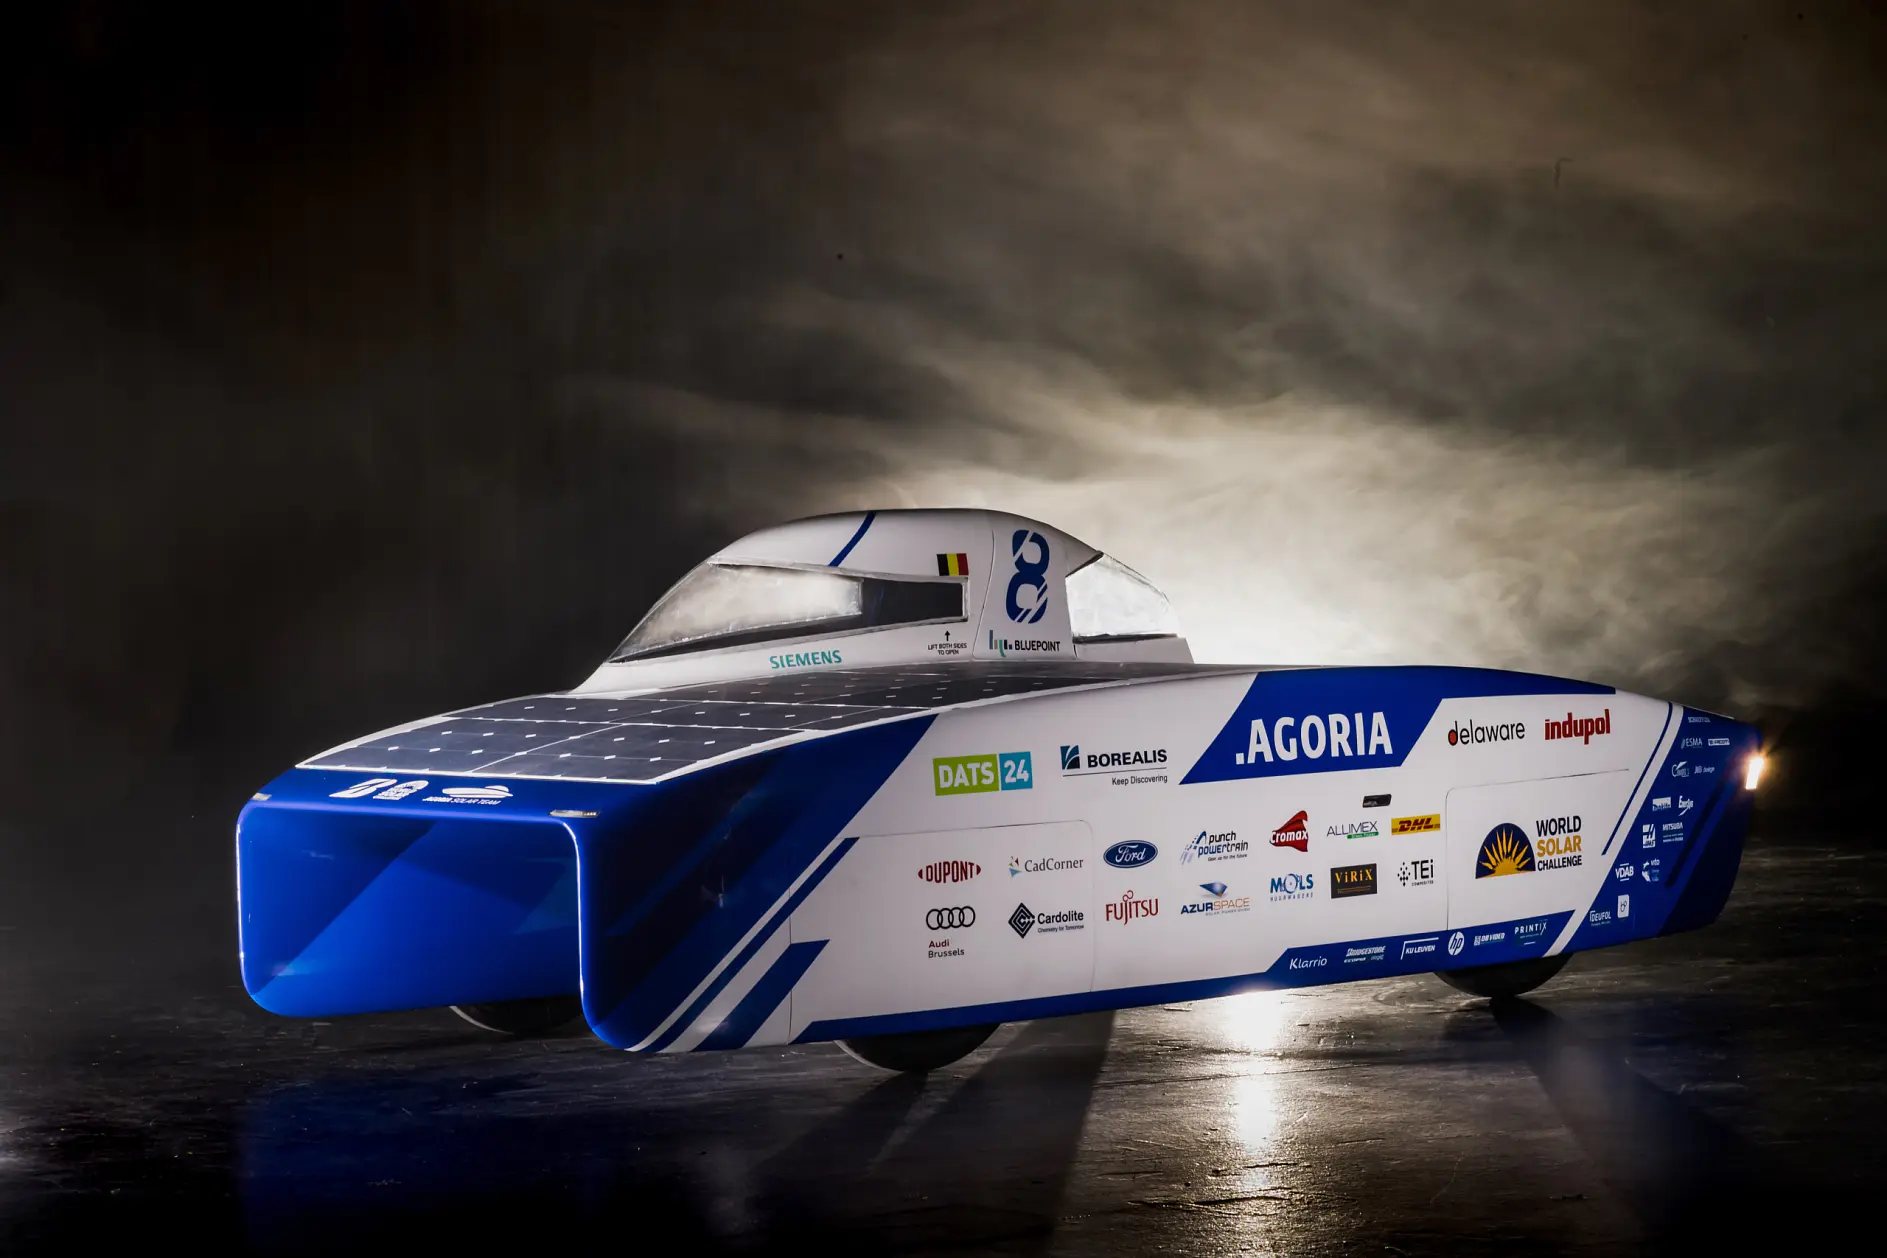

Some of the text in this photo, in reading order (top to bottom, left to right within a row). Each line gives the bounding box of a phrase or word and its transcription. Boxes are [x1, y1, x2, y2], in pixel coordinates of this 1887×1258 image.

[1006, 530, 1050, 624] 8
[1014, 640, 1060, 652] BLUEPOINT
[769, 650, 842, 669] SIEMENS
[1448, 719, 1525, 746] delaware
[1544, 708, 1611, 745] indupol
[1087, 749, 1168, 768] BOREALIS
[938, 758, 1030, 789] DATS 24
[1112, 773, 1168, 787] Keep Discovering
[1326, 820, 1378, 837] ALLIMEX
[1398, 817, 1434, 833] DHL
[1536, 815, 1582, 837] WORLD
[1208, 830, 1236, 845] punch
[1269, 829, 1308, 844] Cromax
[1115, 844, 1146, 863] Ford
[1198, 840, 1249, 858] powertrain
[1536, 835, 1582, 857] SOLAR
[1024, 857, 1084, 872] CadCorner
[1537, 855, 1582, 871] CHALLENGE
[925, 860, 974, 884] DUPONT
[1615, 866, 1634, 879] VDAB
[1269, 873, 1314, 894] MOLS
[1105, 890, 1159, 925] FUJITSU
[1037, 910, 1084, 924] Cardolite
[1591, 911, 1612, 922] DEUFOL
[1514, 922, 1547, 935] PRINTIX
[928, 939, 950, 949] Audi
[1414, 945, 1436, 953] LEUVEN
[1449, 932, 1464, 955] hp
[928, 948, 965, 958] Brussels
[1289, 956, 1328, 970] Klarrio
